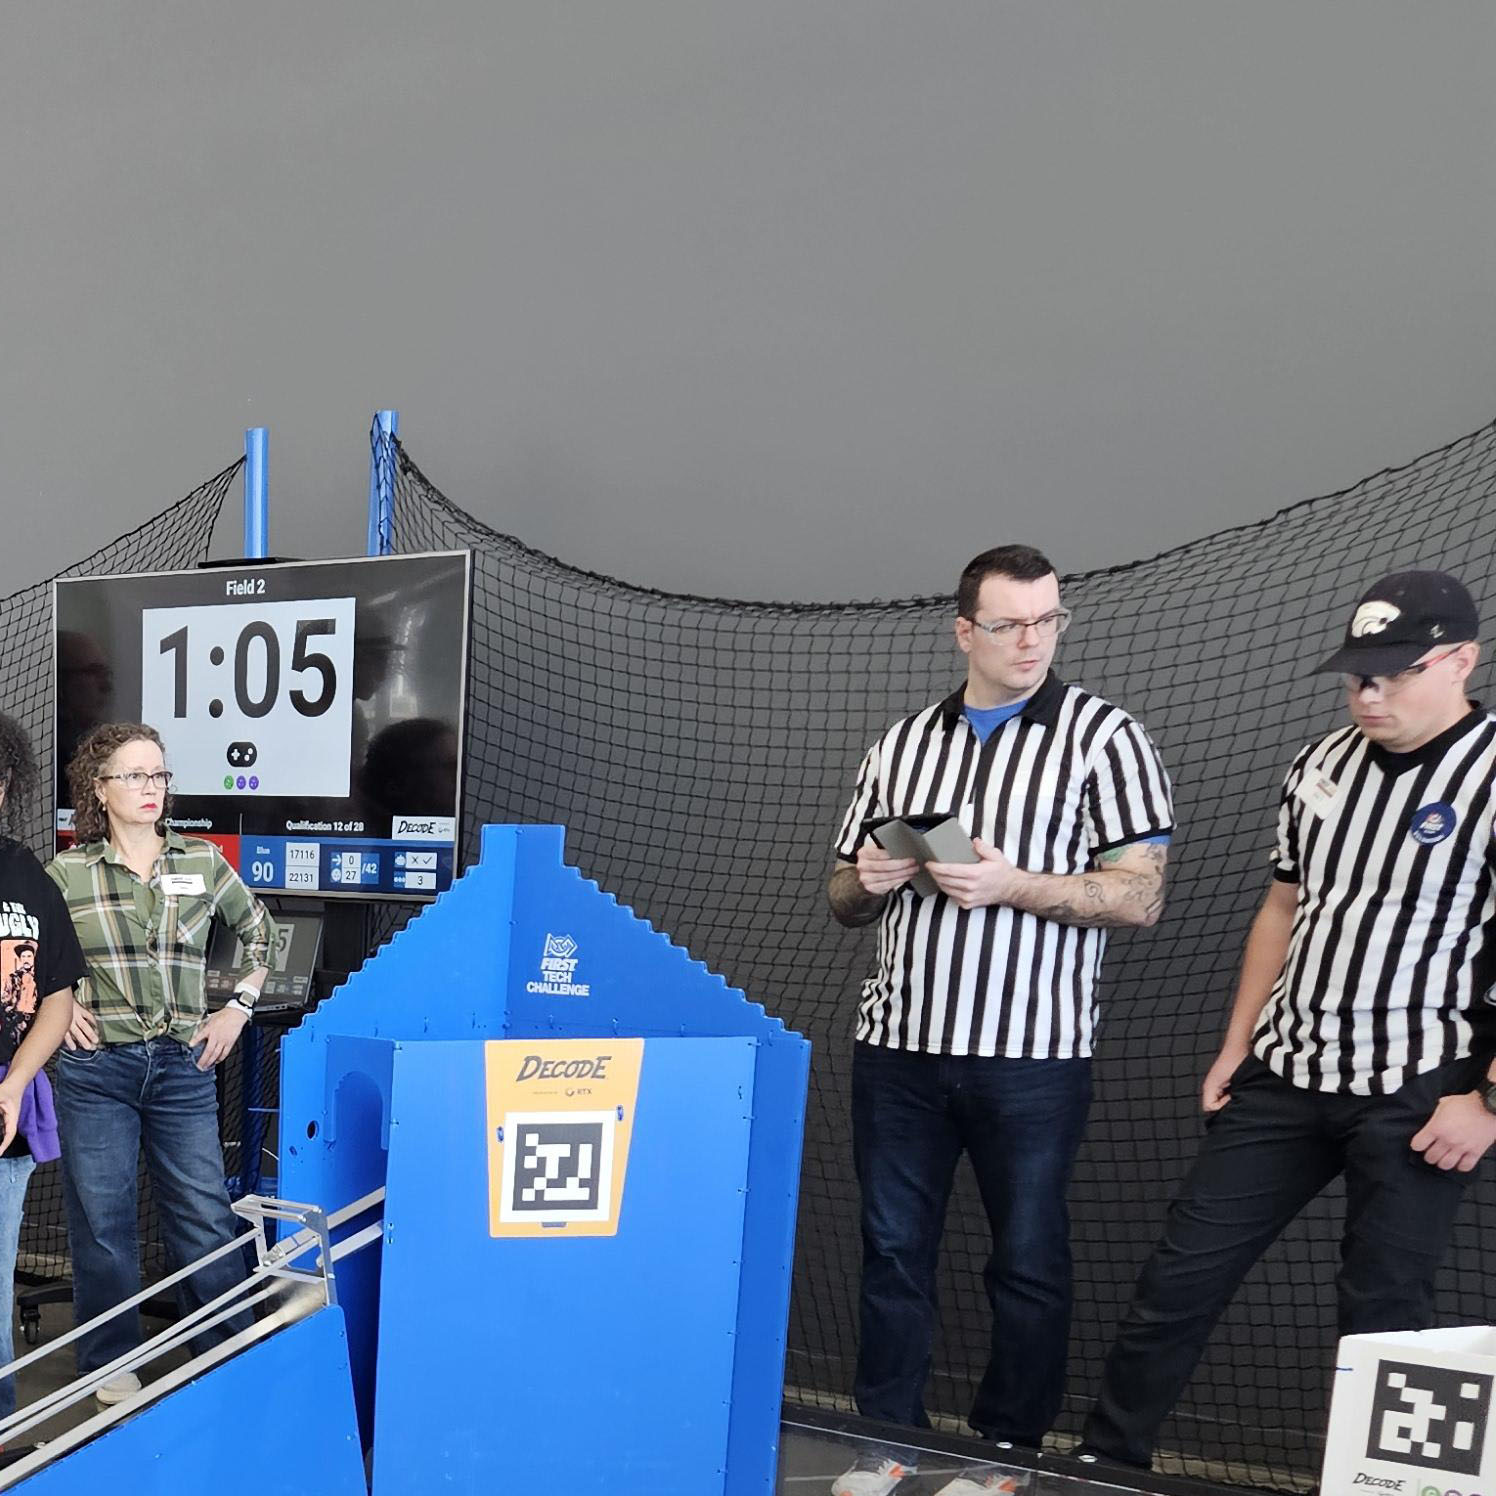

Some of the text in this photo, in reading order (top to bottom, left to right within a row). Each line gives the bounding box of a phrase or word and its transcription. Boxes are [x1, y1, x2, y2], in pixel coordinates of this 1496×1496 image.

[226, 578, 266, 596] Field 2
[159, 617, 338, 720] 1:05
[286, 819, 332, 832] Qualification
[333, 821, 343, 832] 12
[344, 821, 353, 832] of
[398, 820, 437, 835] DECODE
[290, 849, 315, 860] 17116
[348, 855, 355, 866] 0
[251, 860, 274, 883] 90
[289, 872, 314, 883] 22131
[345, 870, 357, 881] 27
[417, 875, 424, 886] 3
[540, 957, 579, 972] FIRST
[542, 970, 573, 984] TECH
[526, 981, 591, 997] CHALLENGE
[515, 1055, 613, 1082] DECODE
[1352, 1472, 1407, 1492] DECODE
